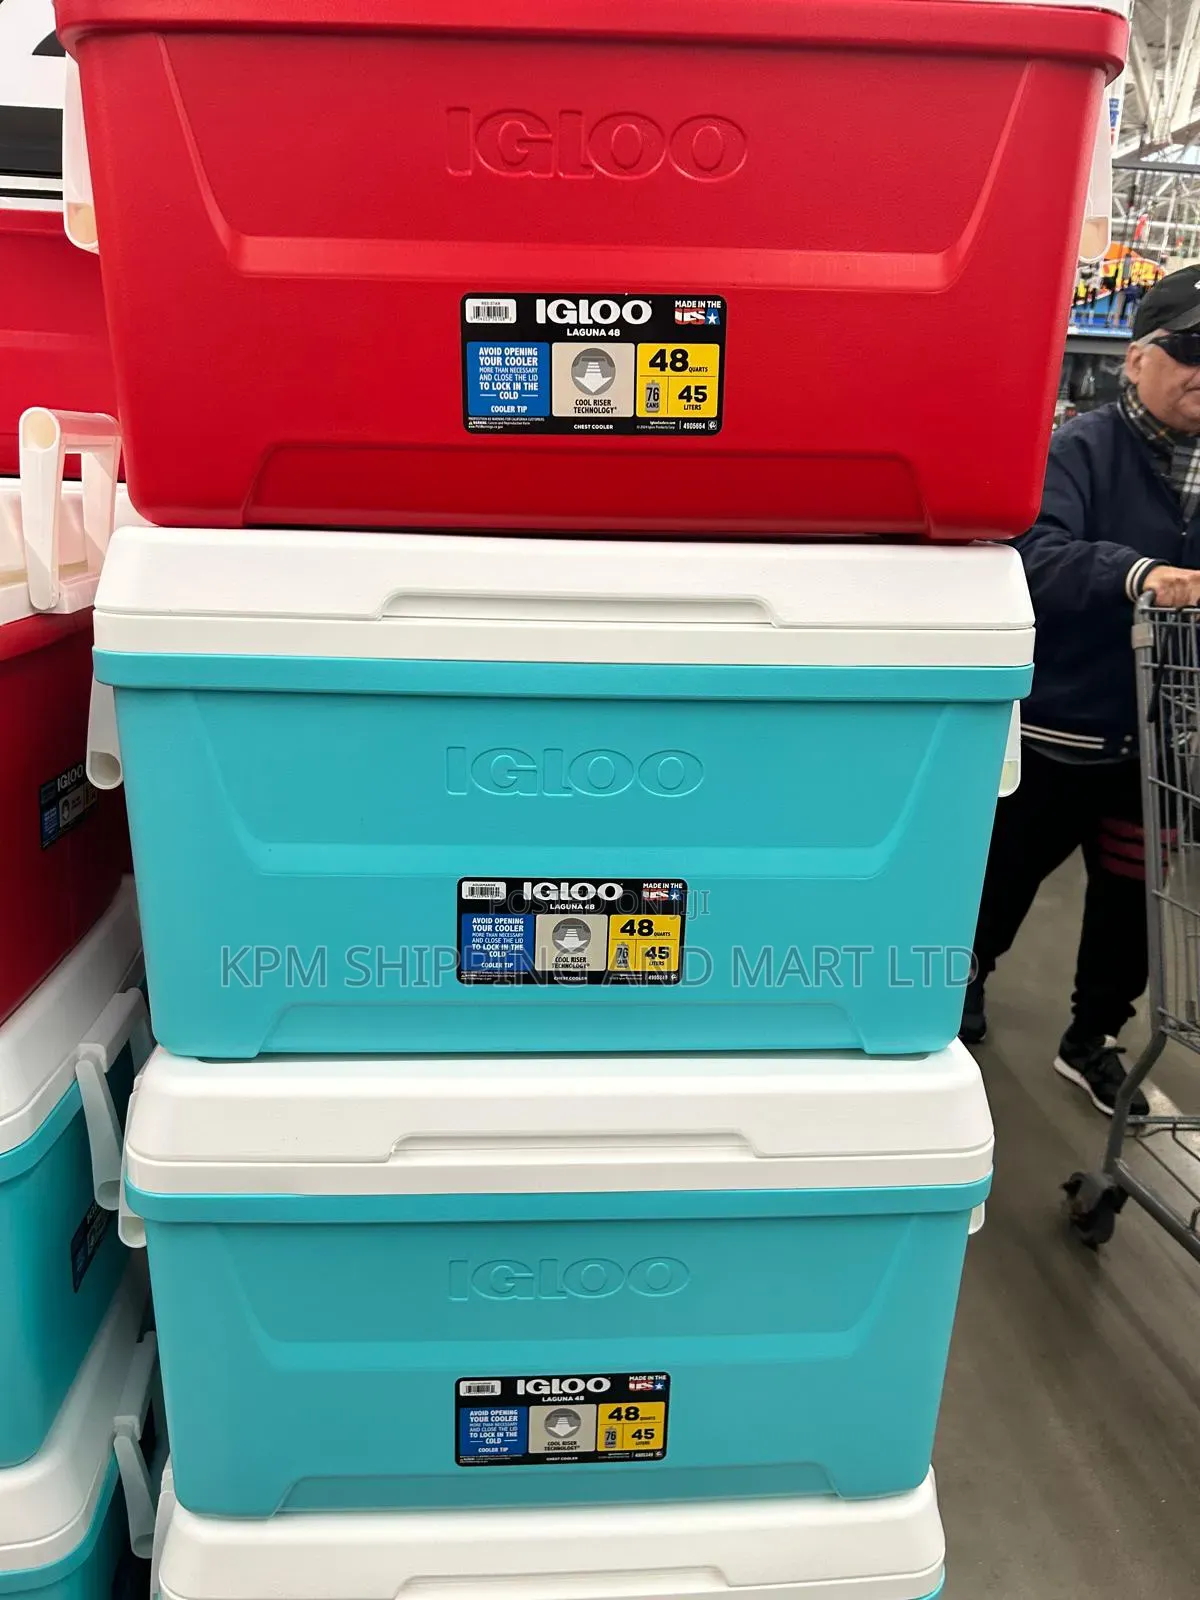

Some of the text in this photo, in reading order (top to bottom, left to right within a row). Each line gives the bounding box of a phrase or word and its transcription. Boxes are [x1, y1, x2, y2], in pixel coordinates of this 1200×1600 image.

[446, 107, 748, 183] IGLOO
[536, 299, 652, 324] IGLOO
[674, 308, 720, 325] USA
[567, 328, 620, 336] LAGUNA 48
[479, 347, 538, 356] AVOID OPENING
[480, 357, 538, 366] YOUR COOLER
[649, 348, 688, 372] 48
[480, 382, 538, 391] TO LOCK IN THE
[647, 387, 659, 401] 76
[678, 385, 707, 403] 45
[499, 391, 518, 400] COLD
[491, 405, 528, 413] COOLER TIP
[57, 764, 84, 792] IGLOO
[446, 747, 704, 797] IGLOO
[523, 882, 623, 900] IGLOO
[620, 919, 654, 936] 48
[617, 947, 629, 958] 76
[645, 946, 669, 960] 45
[449, 1256, 691, 1301] IGLOO
[517, 1377, 611, 1395] IGLOO
[608, 1406, 640, 1421] 48
[605, 1431, 616, 1441] 76
[631, 1428, 655, 1440] 45
